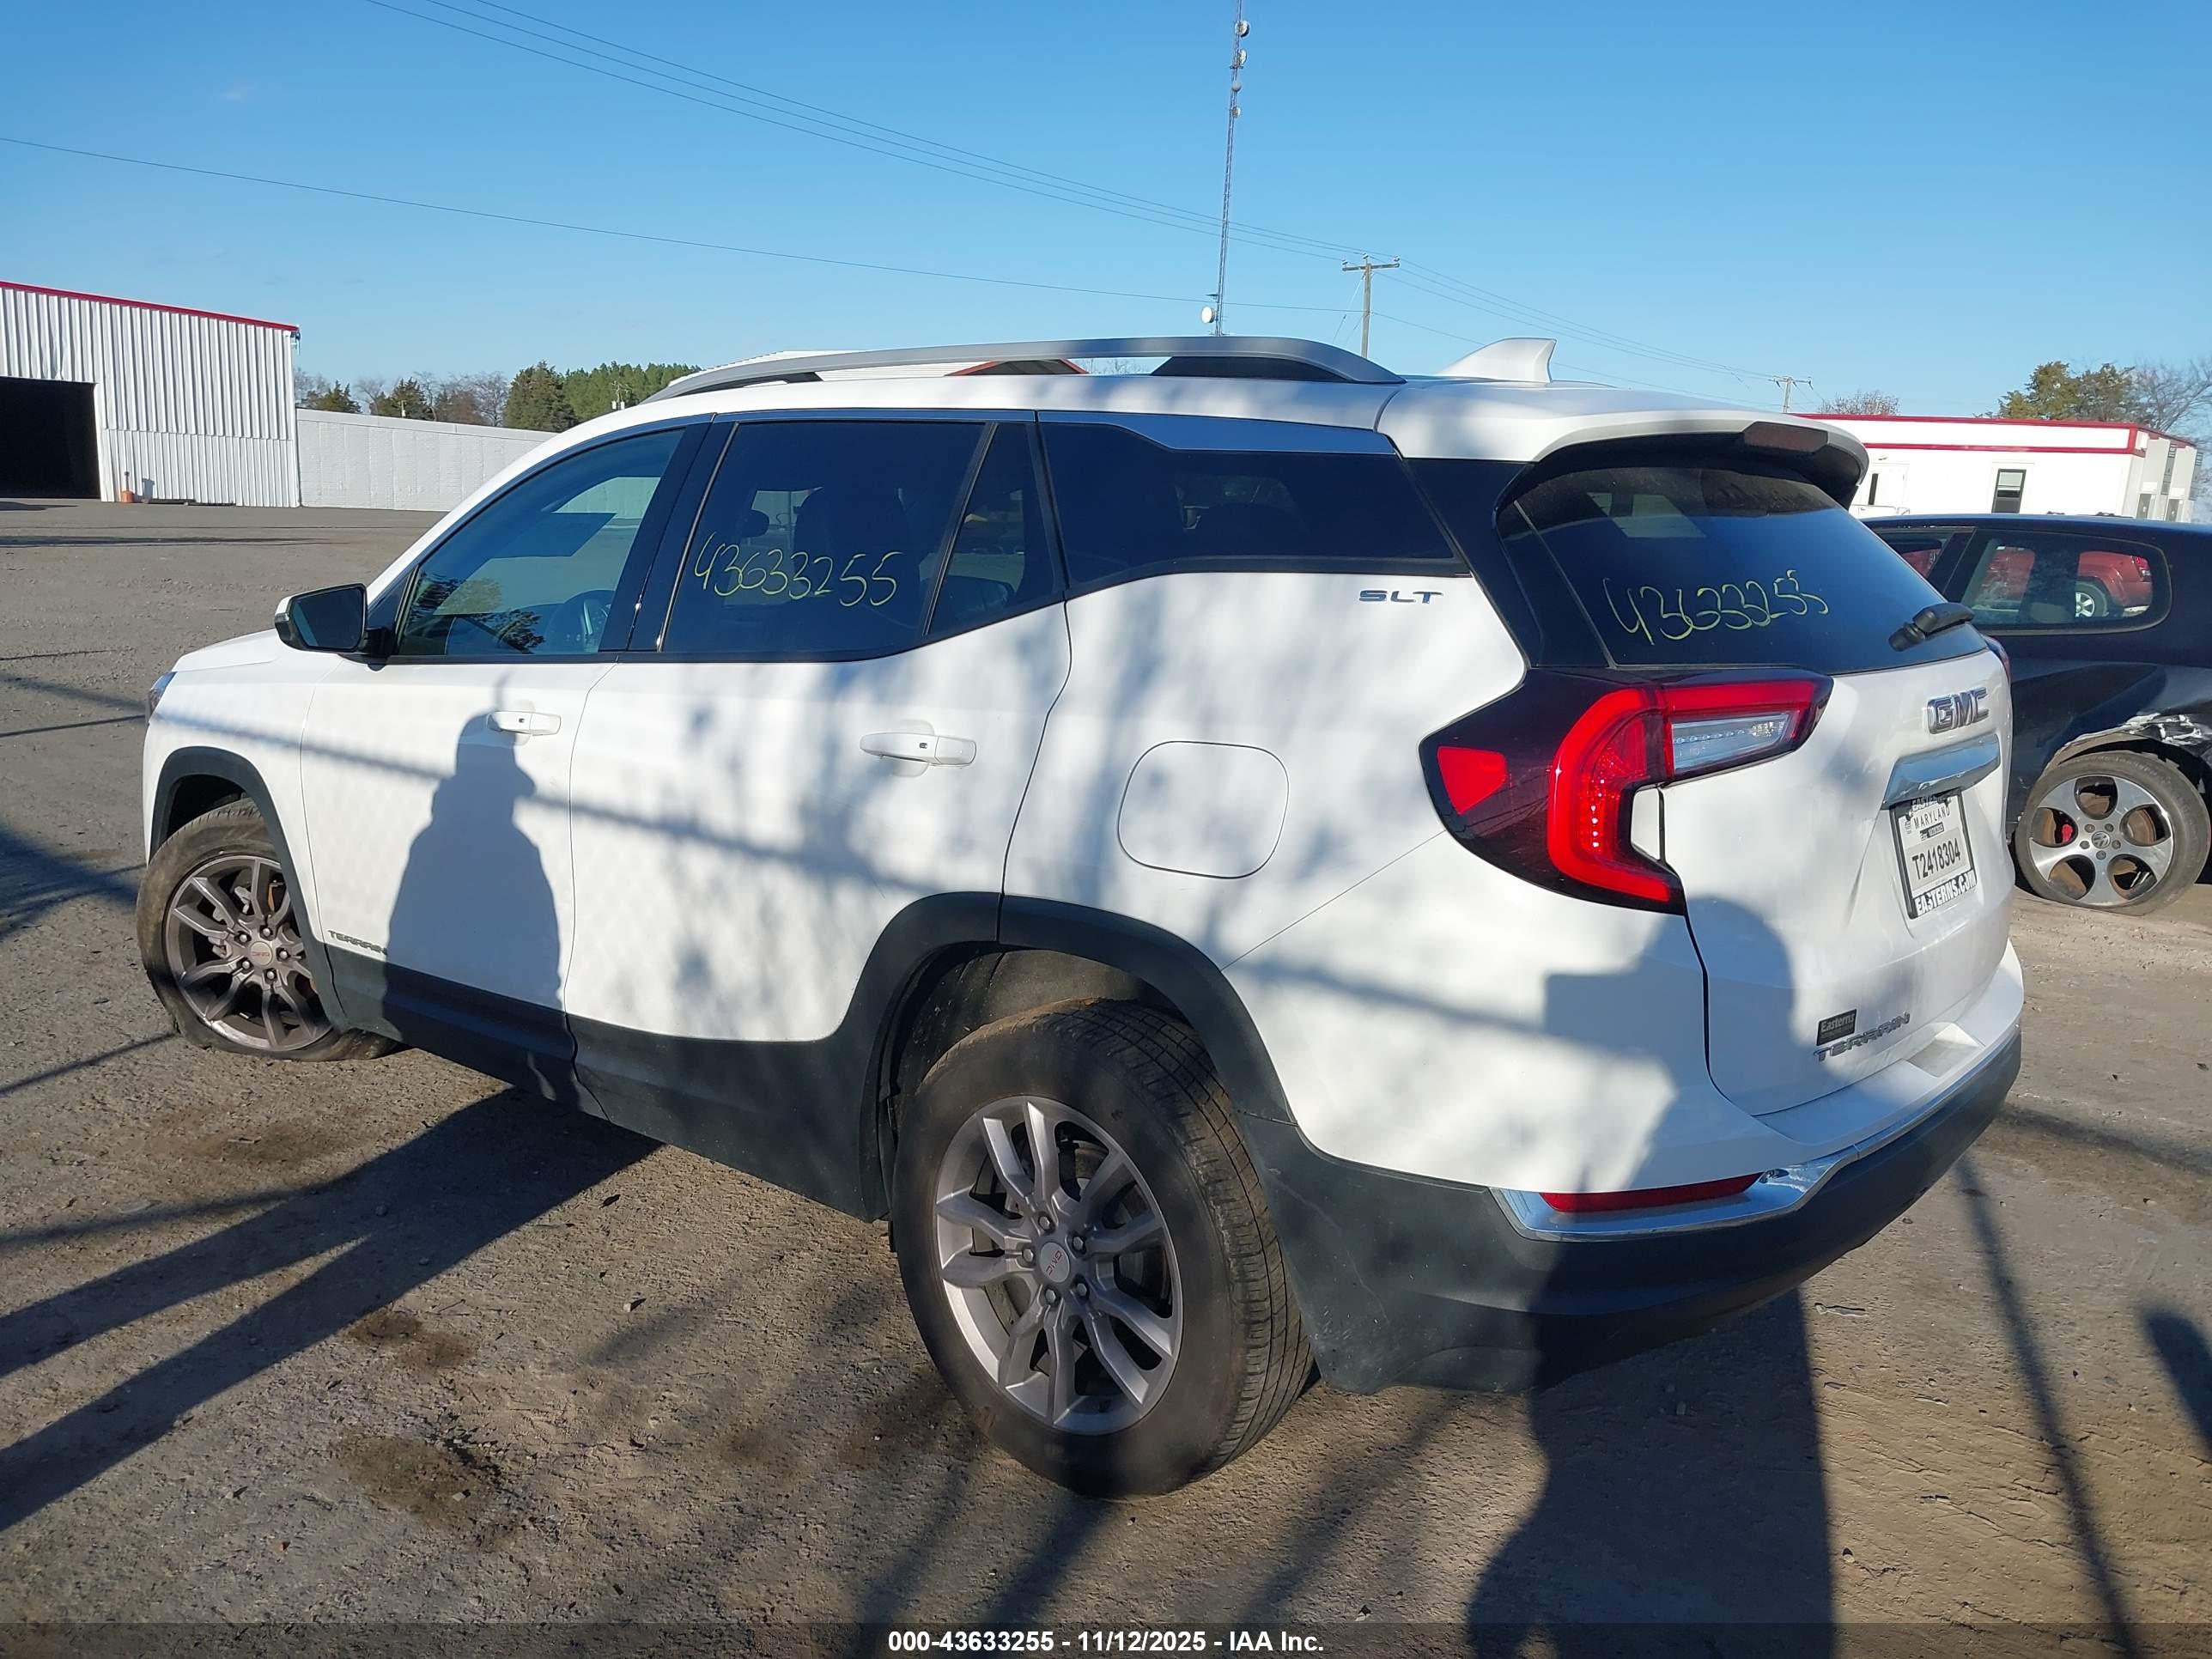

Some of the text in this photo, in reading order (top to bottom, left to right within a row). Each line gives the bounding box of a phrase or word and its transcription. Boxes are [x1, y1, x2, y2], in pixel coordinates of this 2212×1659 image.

[694, 532, 902, 606] 43633255
[1358, 589, 1443, 604] SLT
[1926, 687, 1990, 734] GMC
[1913, 805, 1950, 830] MARYLAND
[1911, 838, 1960, 879] T2418304
[1813, 1012, 1911, 1062] TERRAIN
